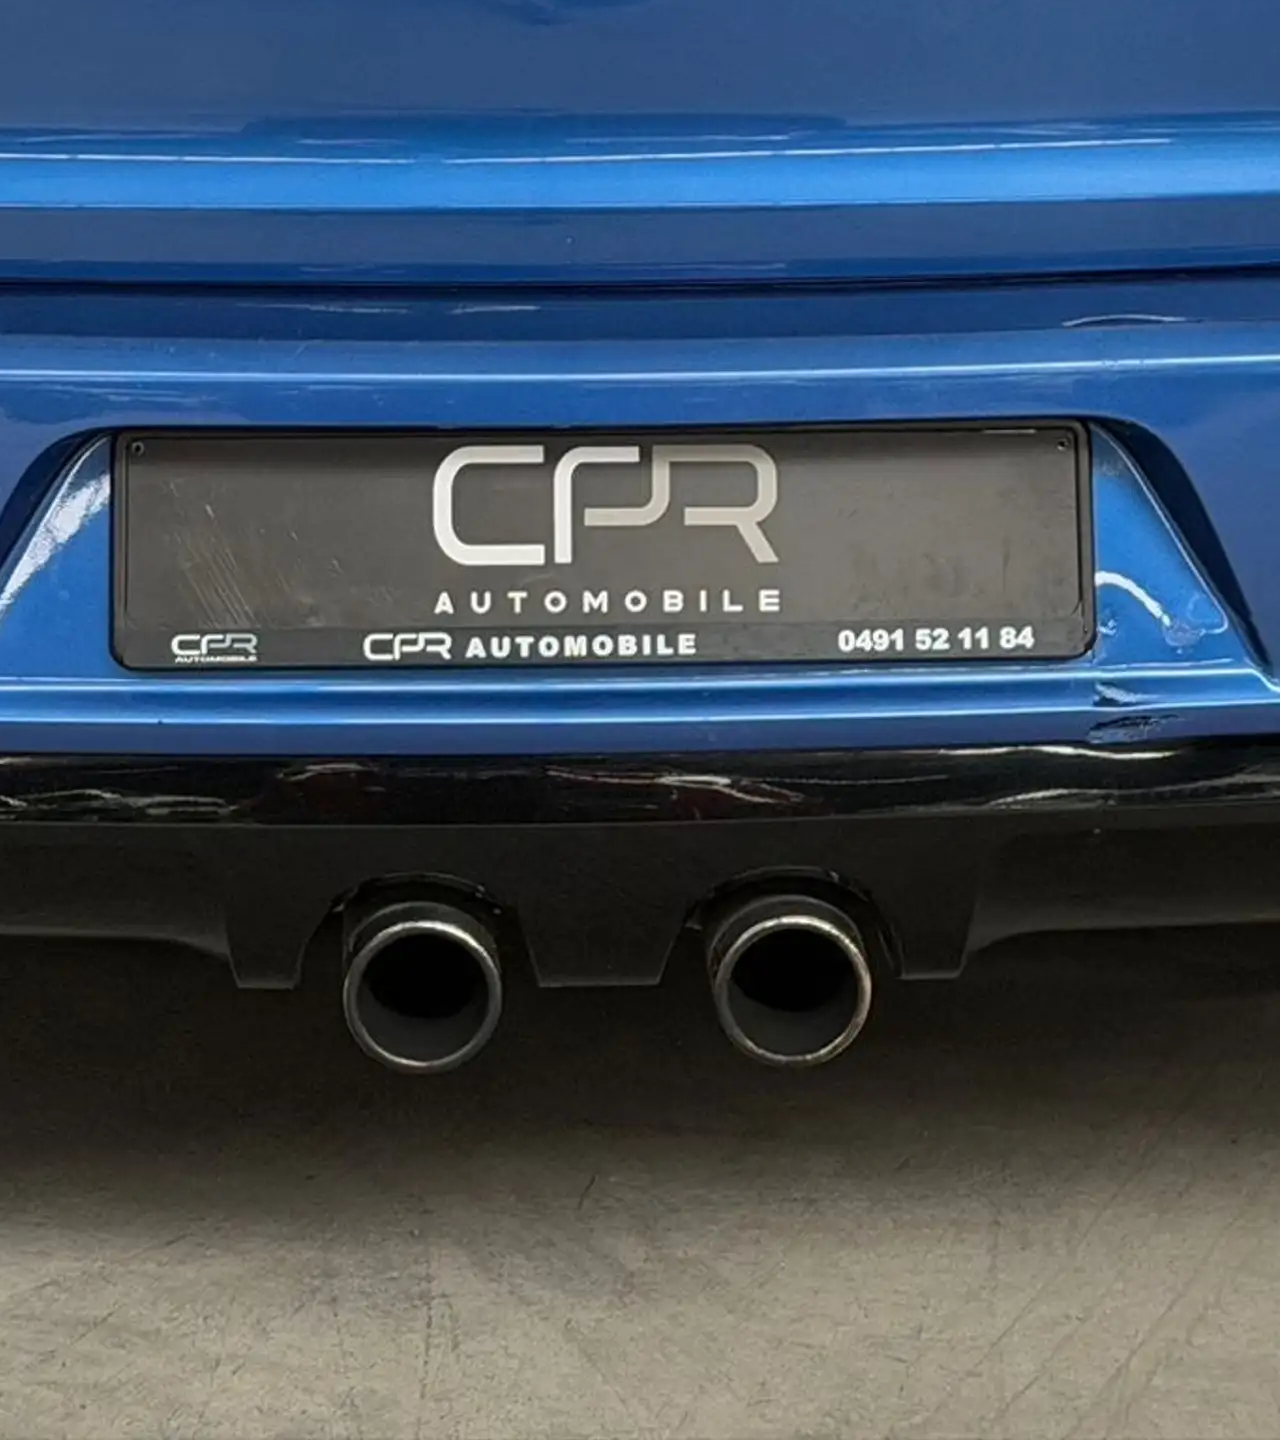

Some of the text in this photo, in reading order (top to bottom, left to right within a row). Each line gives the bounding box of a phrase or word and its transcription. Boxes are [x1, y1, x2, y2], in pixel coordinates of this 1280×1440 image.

[433, 444, 779, 566] CPR
[434, 590, 781, 614] AUTOMOBILE
[171, 633, 258, 656] CPR
[363, 632, 697, 661] CPR AUTOMOBILE
[837, 625, 1035, 652] 0491 52 11 84
